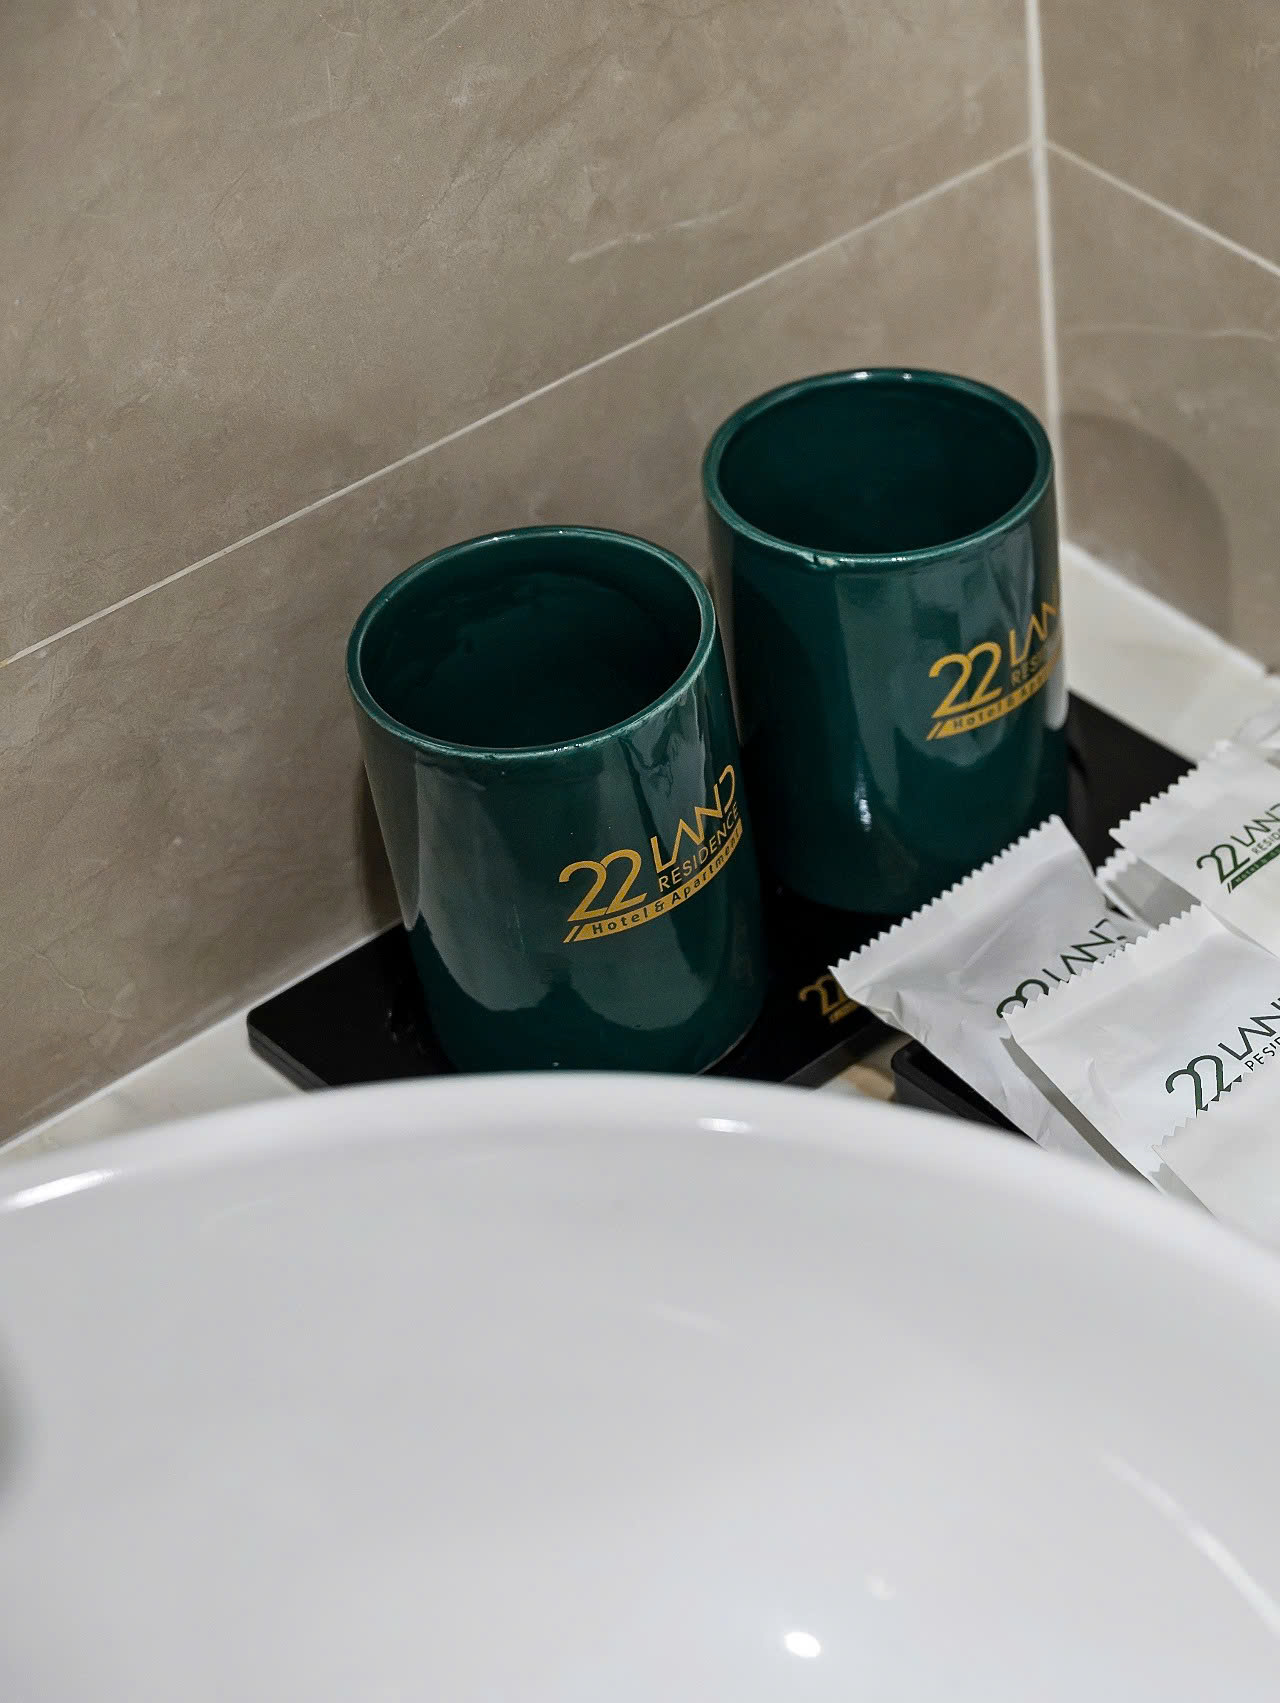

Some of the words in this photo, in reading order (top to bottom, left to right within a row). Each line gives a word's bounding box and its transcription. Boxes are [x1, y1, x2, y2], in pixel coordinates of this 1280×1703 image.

[928, 642, 1003, 718] 22
[559, 849, 648, 922] 22
[651, 765, 736, 873] LAND
[592, 907, 650, 935] Hotel
[654, 901, 665, 913] &
[671, 830, 741, 905] Apartment
[658, 802, 739, 892] RESIDENCE
[1196, 844, 1251, 884] 22
[1166, 1054, 1243, 1118] 22
